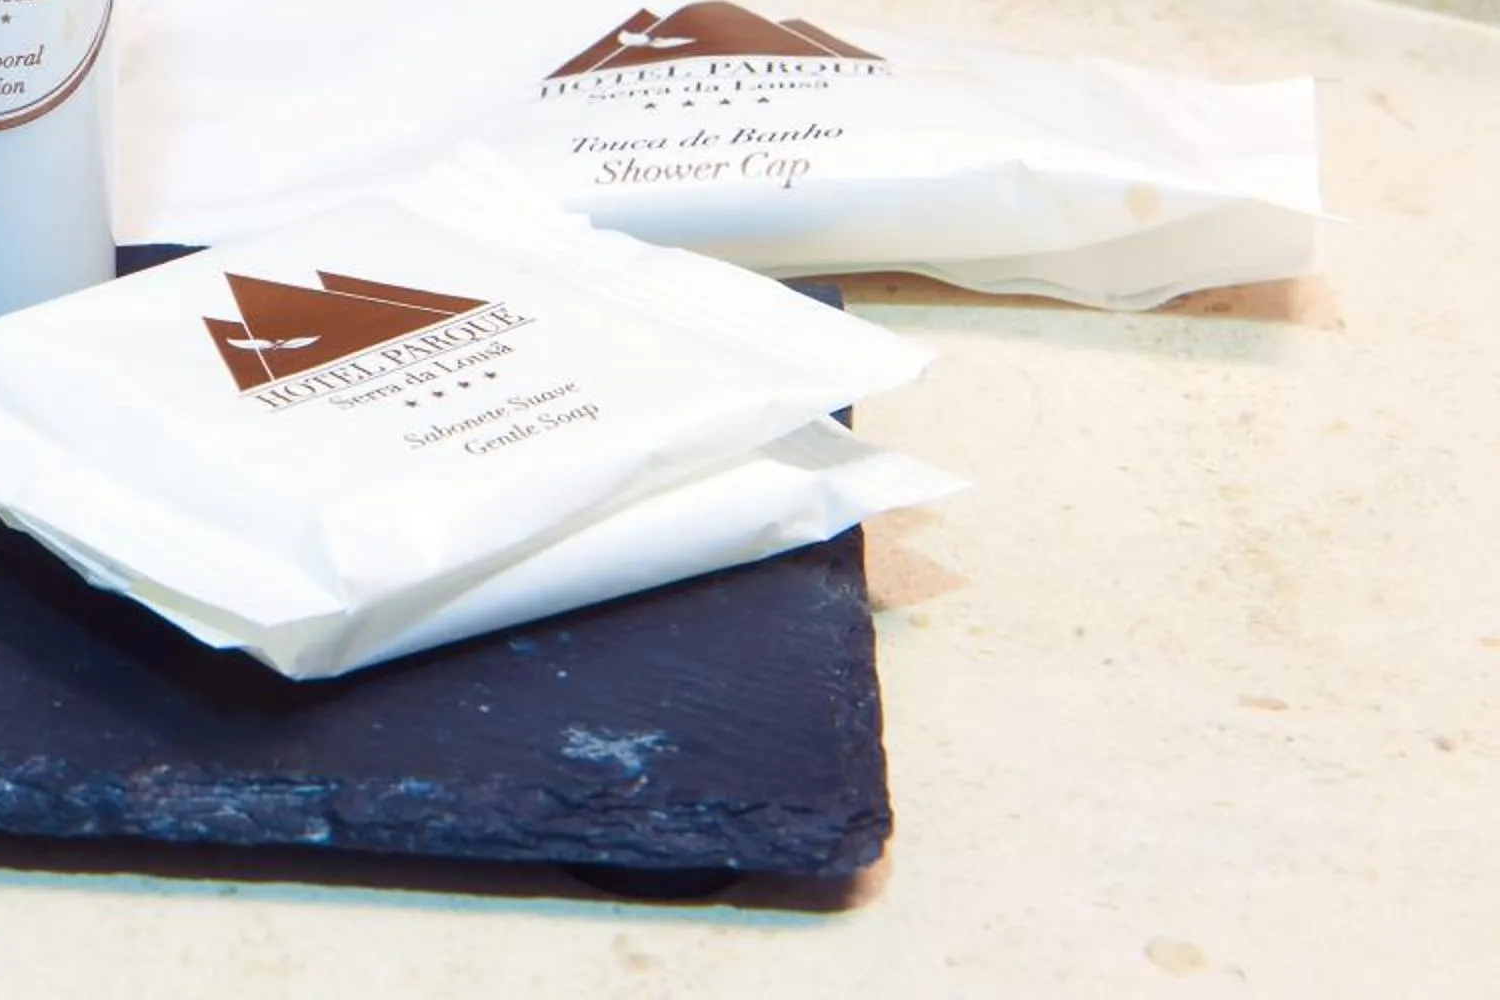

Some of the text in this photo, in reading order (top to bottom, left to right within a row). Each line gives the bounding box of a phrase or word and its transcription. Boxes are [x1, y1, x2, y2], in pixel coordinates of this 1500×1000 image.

[571, 122, 844, 154] Touca de Banho
[595, 151, 811, 190] Shower Cap
[254, 306, 527, 410] HOTEL PARQUE
[327, 340, 514, 410] Serra da Lousã
[403, 379, 581, 450] Sabonete Suave
[464, 401, 601, 456] Gentle Soap
